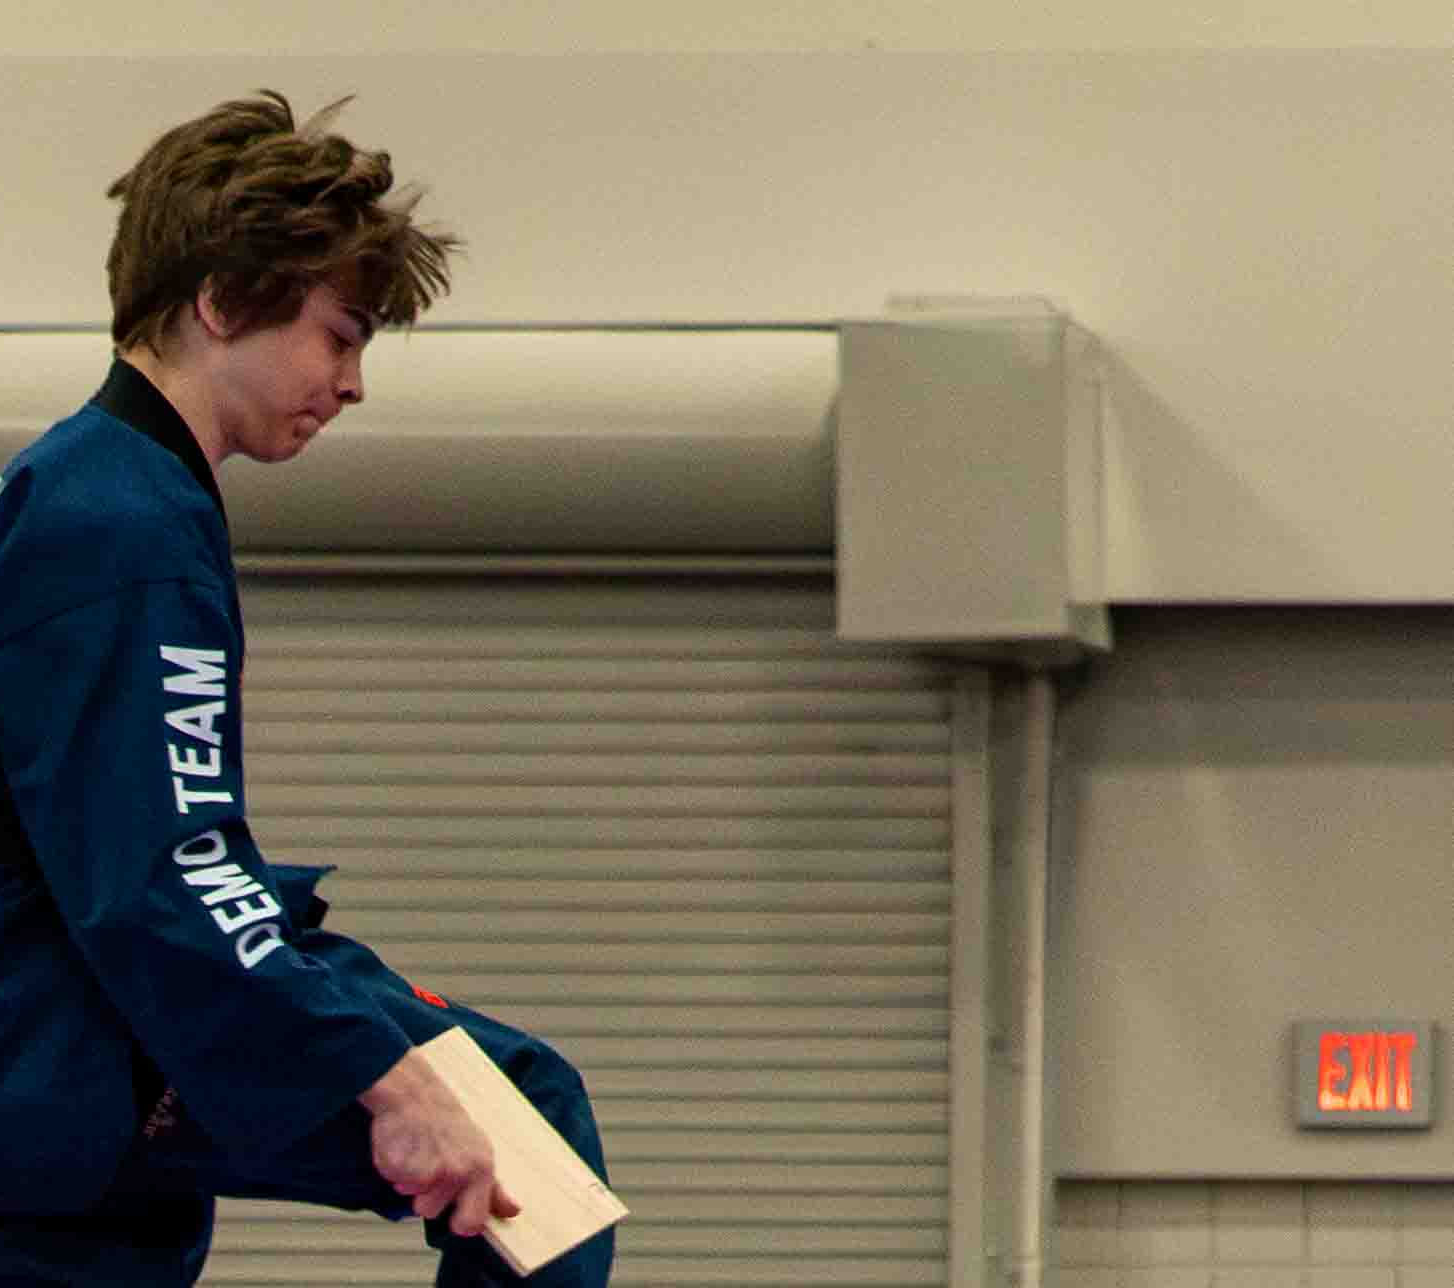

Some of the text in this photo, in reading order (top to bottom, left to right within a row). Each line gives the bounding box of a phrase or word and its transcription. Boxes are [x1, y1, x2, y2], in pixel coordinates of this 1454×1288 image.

[158, 644, 285, 969] DEMO TEAM
[1317, 1031, 1418, 1112] EXIT
